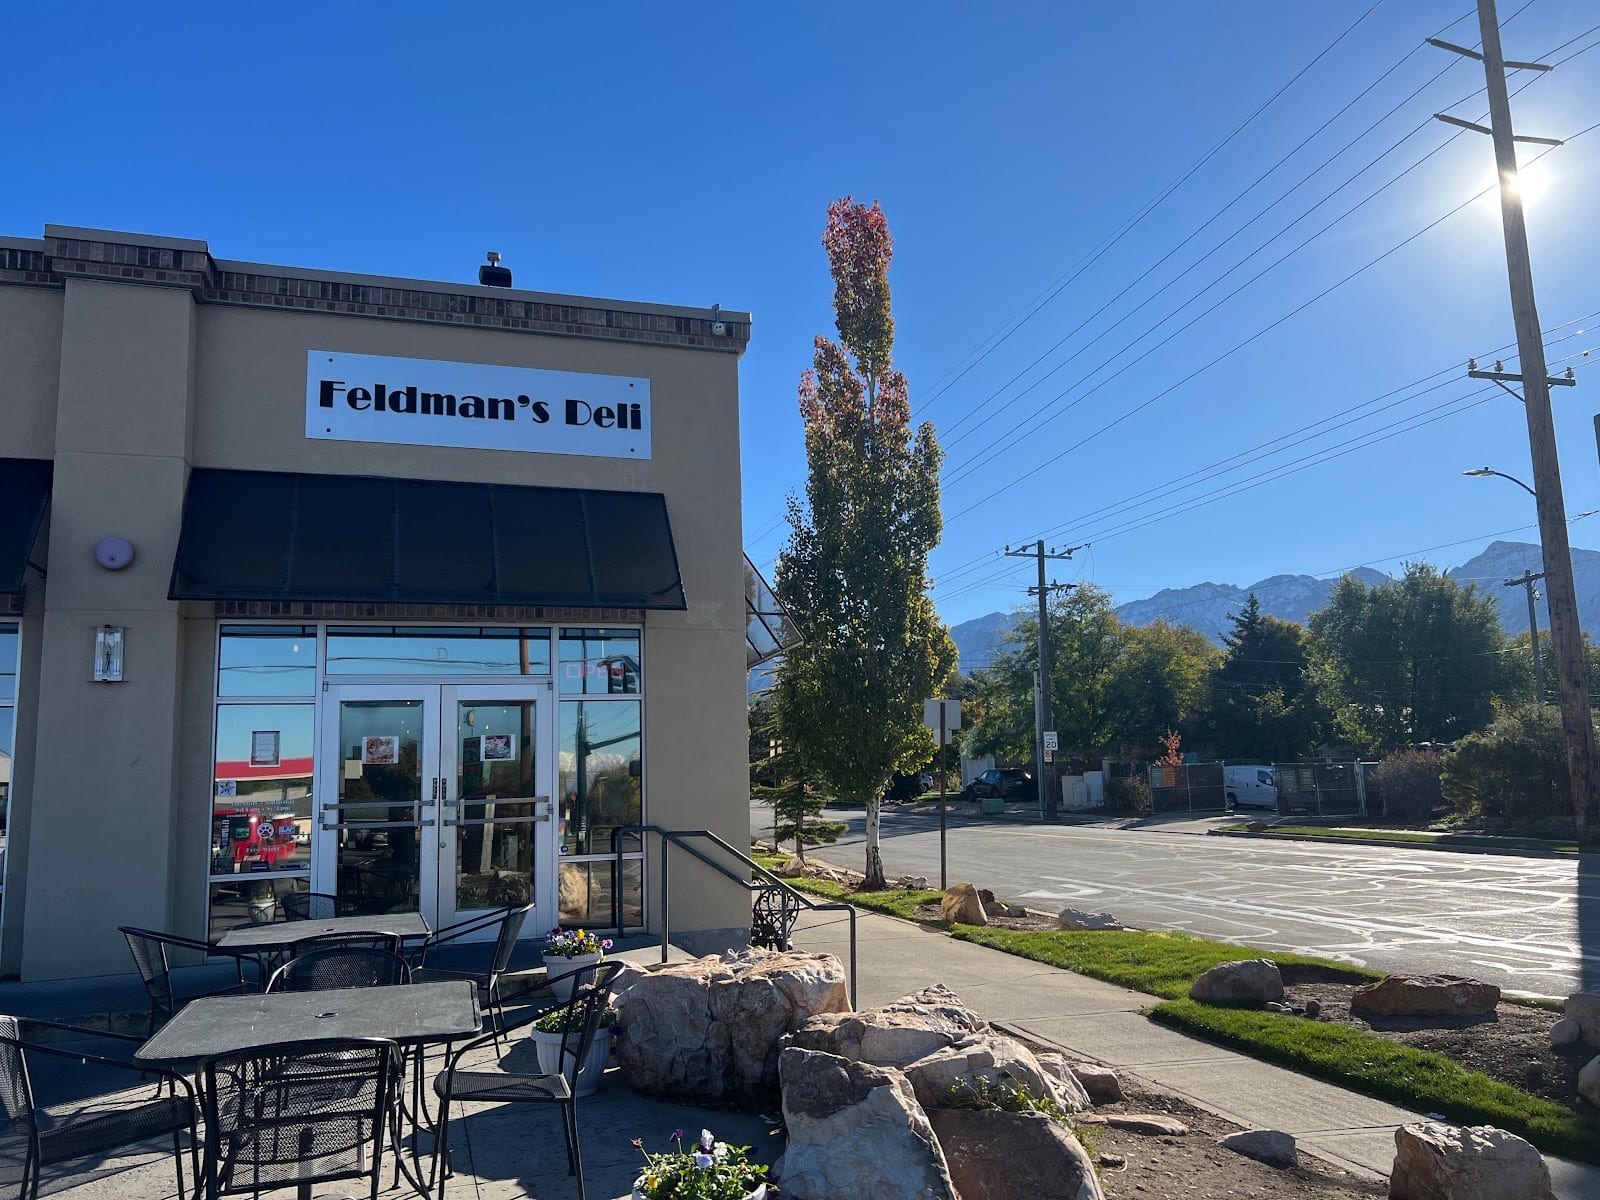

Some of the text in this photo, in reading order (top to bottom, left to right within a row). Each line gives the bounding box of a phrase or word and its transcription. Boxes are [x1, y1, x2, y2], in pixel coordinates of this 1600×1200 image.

[319, 380, 642, 430] Feldman's Deli
[566, 664, 624, 679] OPEN
